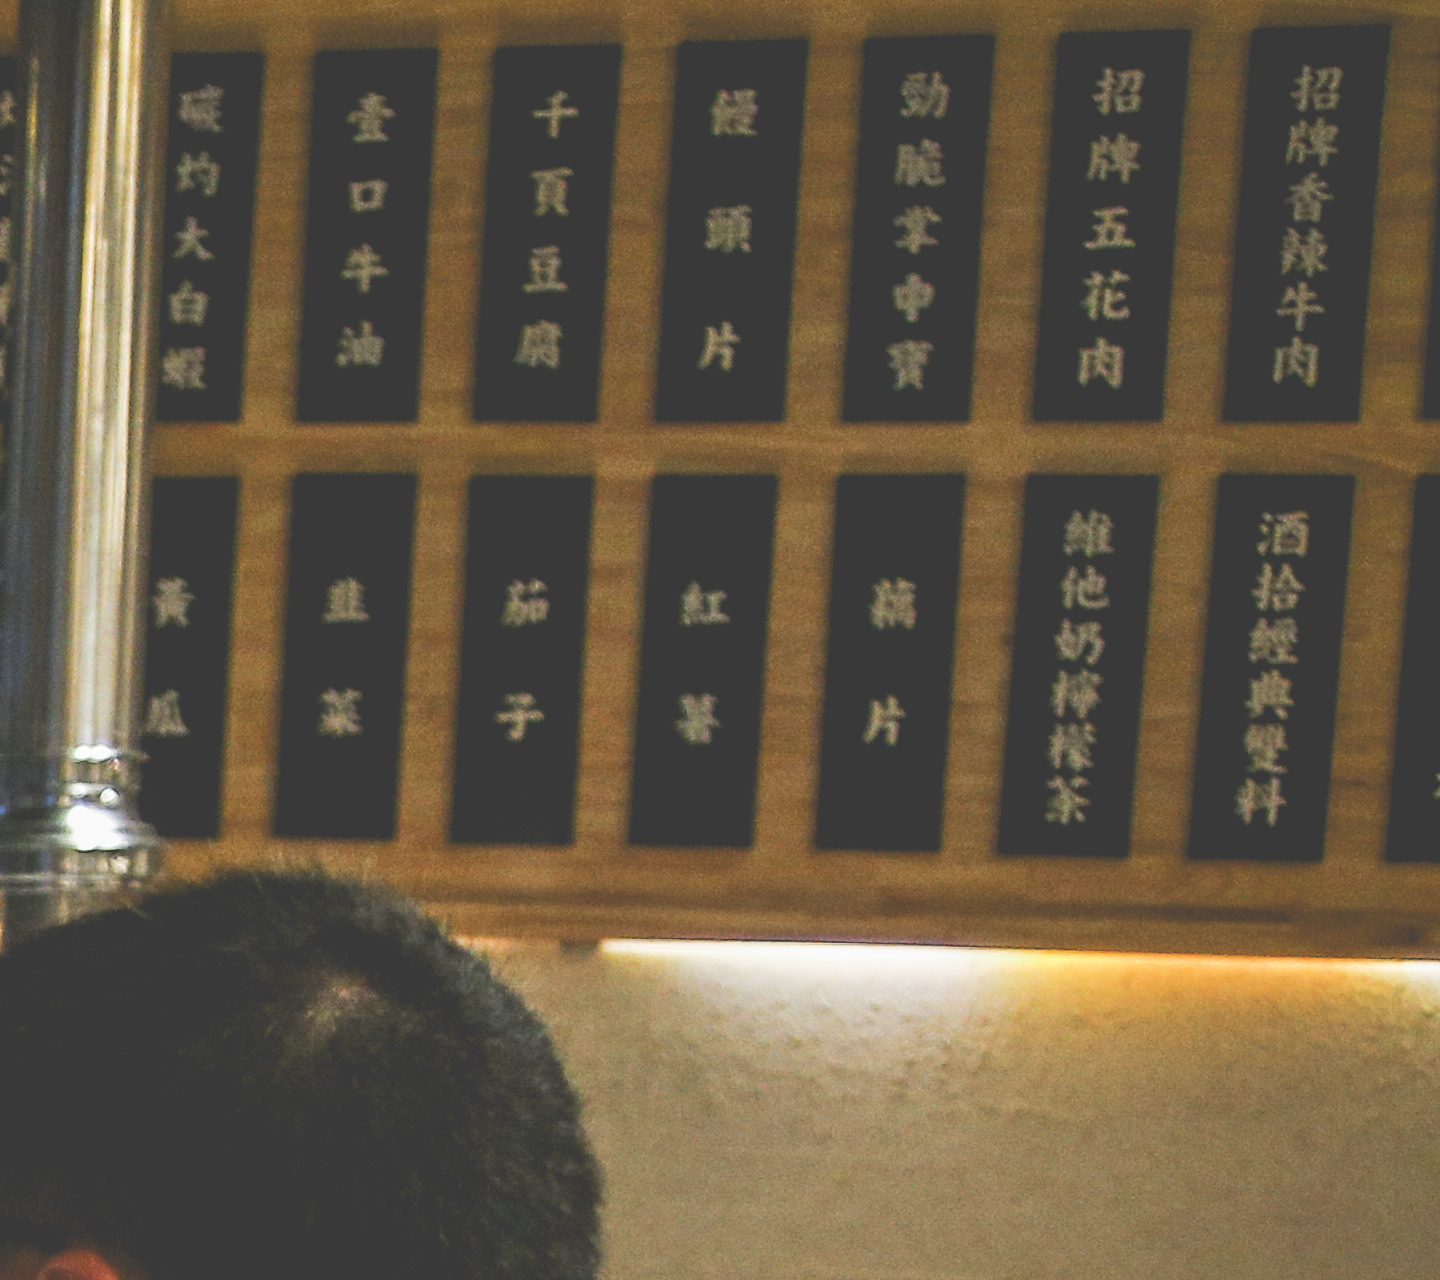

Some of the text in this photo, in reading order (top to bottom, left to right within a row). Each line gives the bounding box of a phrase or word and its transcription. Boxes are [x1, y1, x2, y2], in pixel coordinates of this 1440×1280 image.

[513, 89, 580, 370] 千頁豆腐
[1077, 65, 1146, 390] 招牌五花肉
[1272, 63, 1346, 389] 招牌香辣牛肉
[493, 577, 551, 743] 茄子
